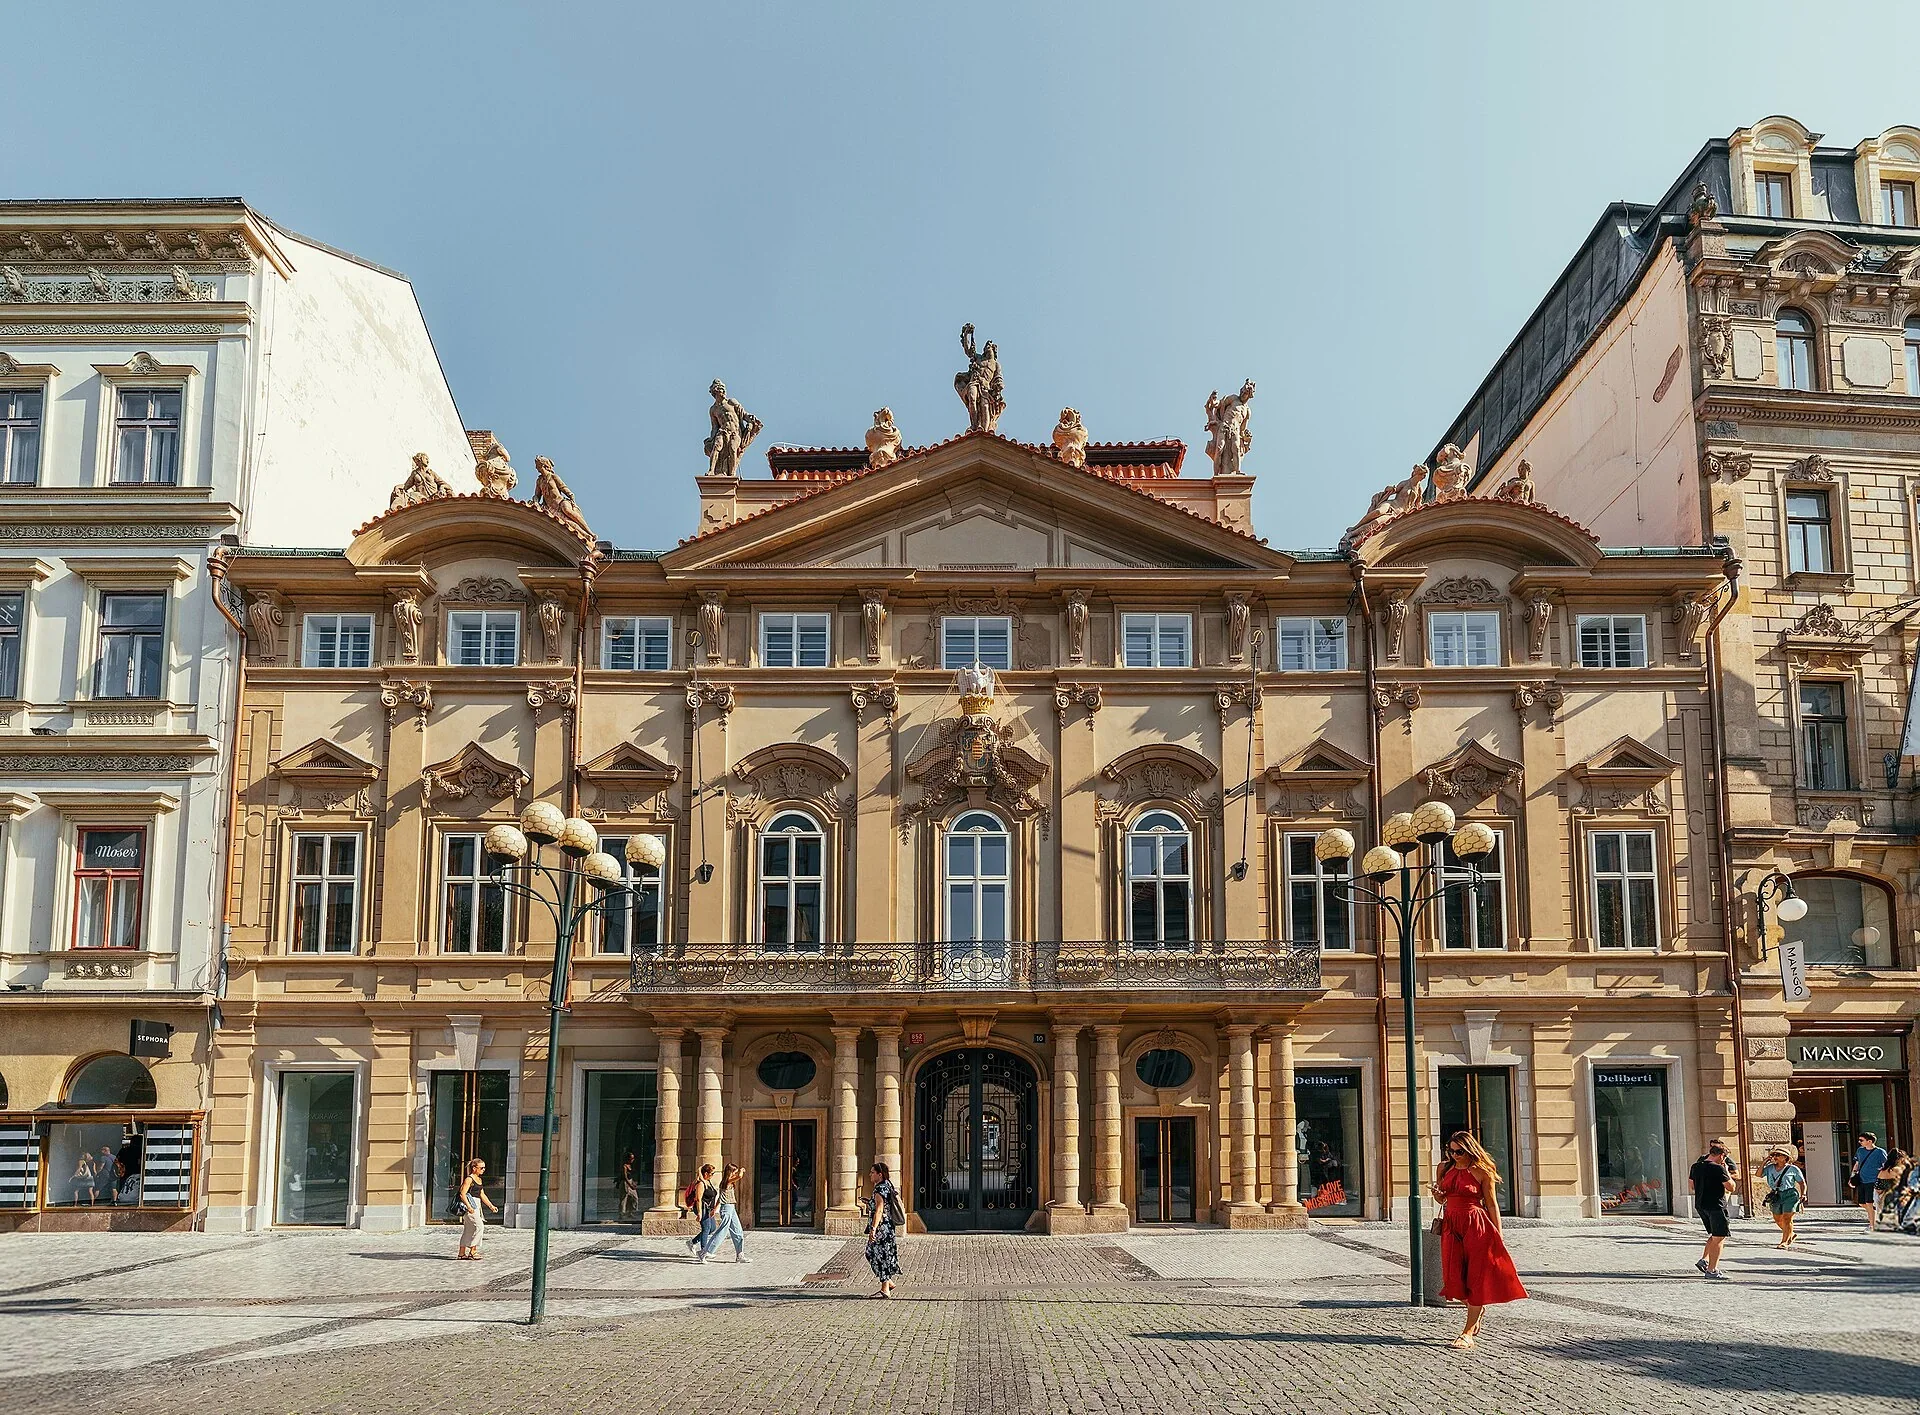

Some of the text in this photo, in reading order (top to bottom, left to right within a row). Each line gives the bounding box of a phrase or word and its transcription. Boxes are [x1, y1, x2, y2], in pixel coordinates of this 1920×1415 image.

[95, 845, 138, 857] Moser
[1787, 946, 1803, 997] MANGO
[137, 1034, 169, 1044] SEPHORA
[1801, 1046, 1884, 1061] MANGO
[1295, 1076, 1349, 1085] Deliberti
[1597, 1074, 1653, 1083] Deliberti
[1320, 1179, 1344, 1195] LOVE
